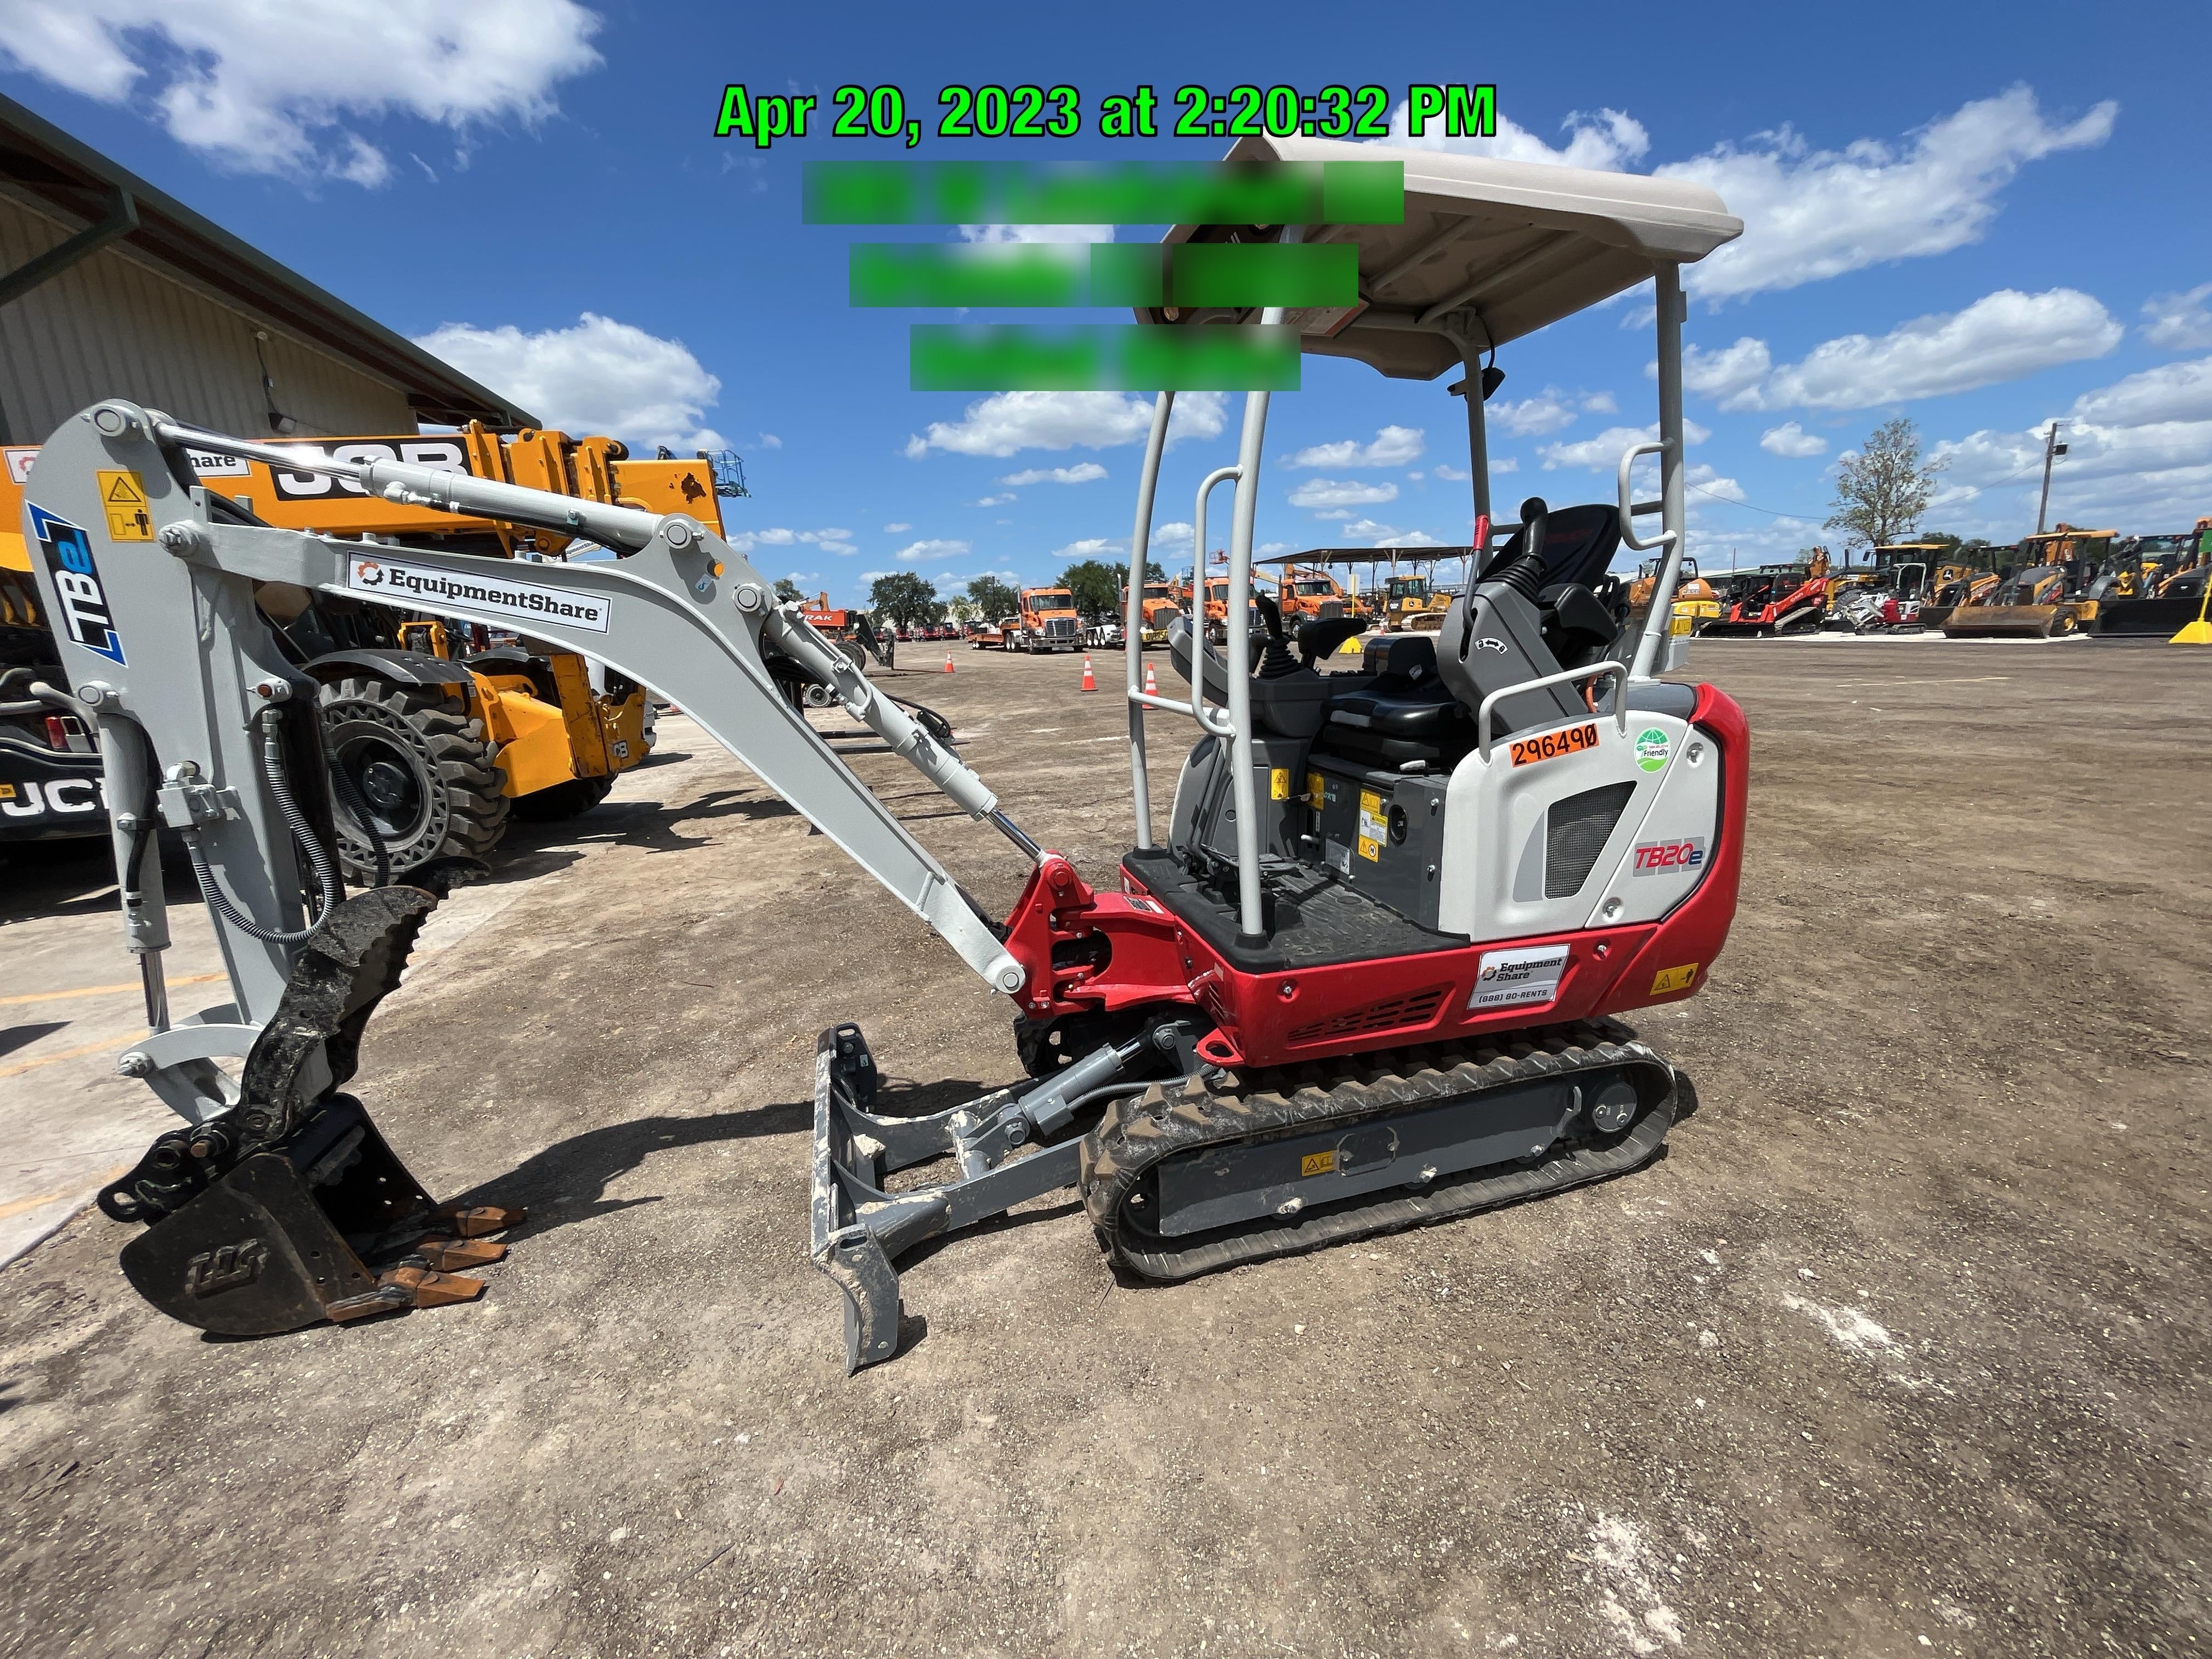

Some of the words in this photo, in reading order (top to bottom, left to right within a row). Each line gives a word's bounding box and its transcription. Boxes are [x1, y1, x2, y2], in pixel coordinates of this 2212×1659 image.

[389, 568, 599, 621] EquipmentShare
[1512, 723, 1598, 766] 296490
[1635, 843, 1703, 869] TB20e
[1499, 958, 1562, 973] Equipment
[1496, 971, 1530, 981] Share
[1479, 994, 1503, 1003] (888)
[1505, 989, 1548, 1000] 80-RENTS
